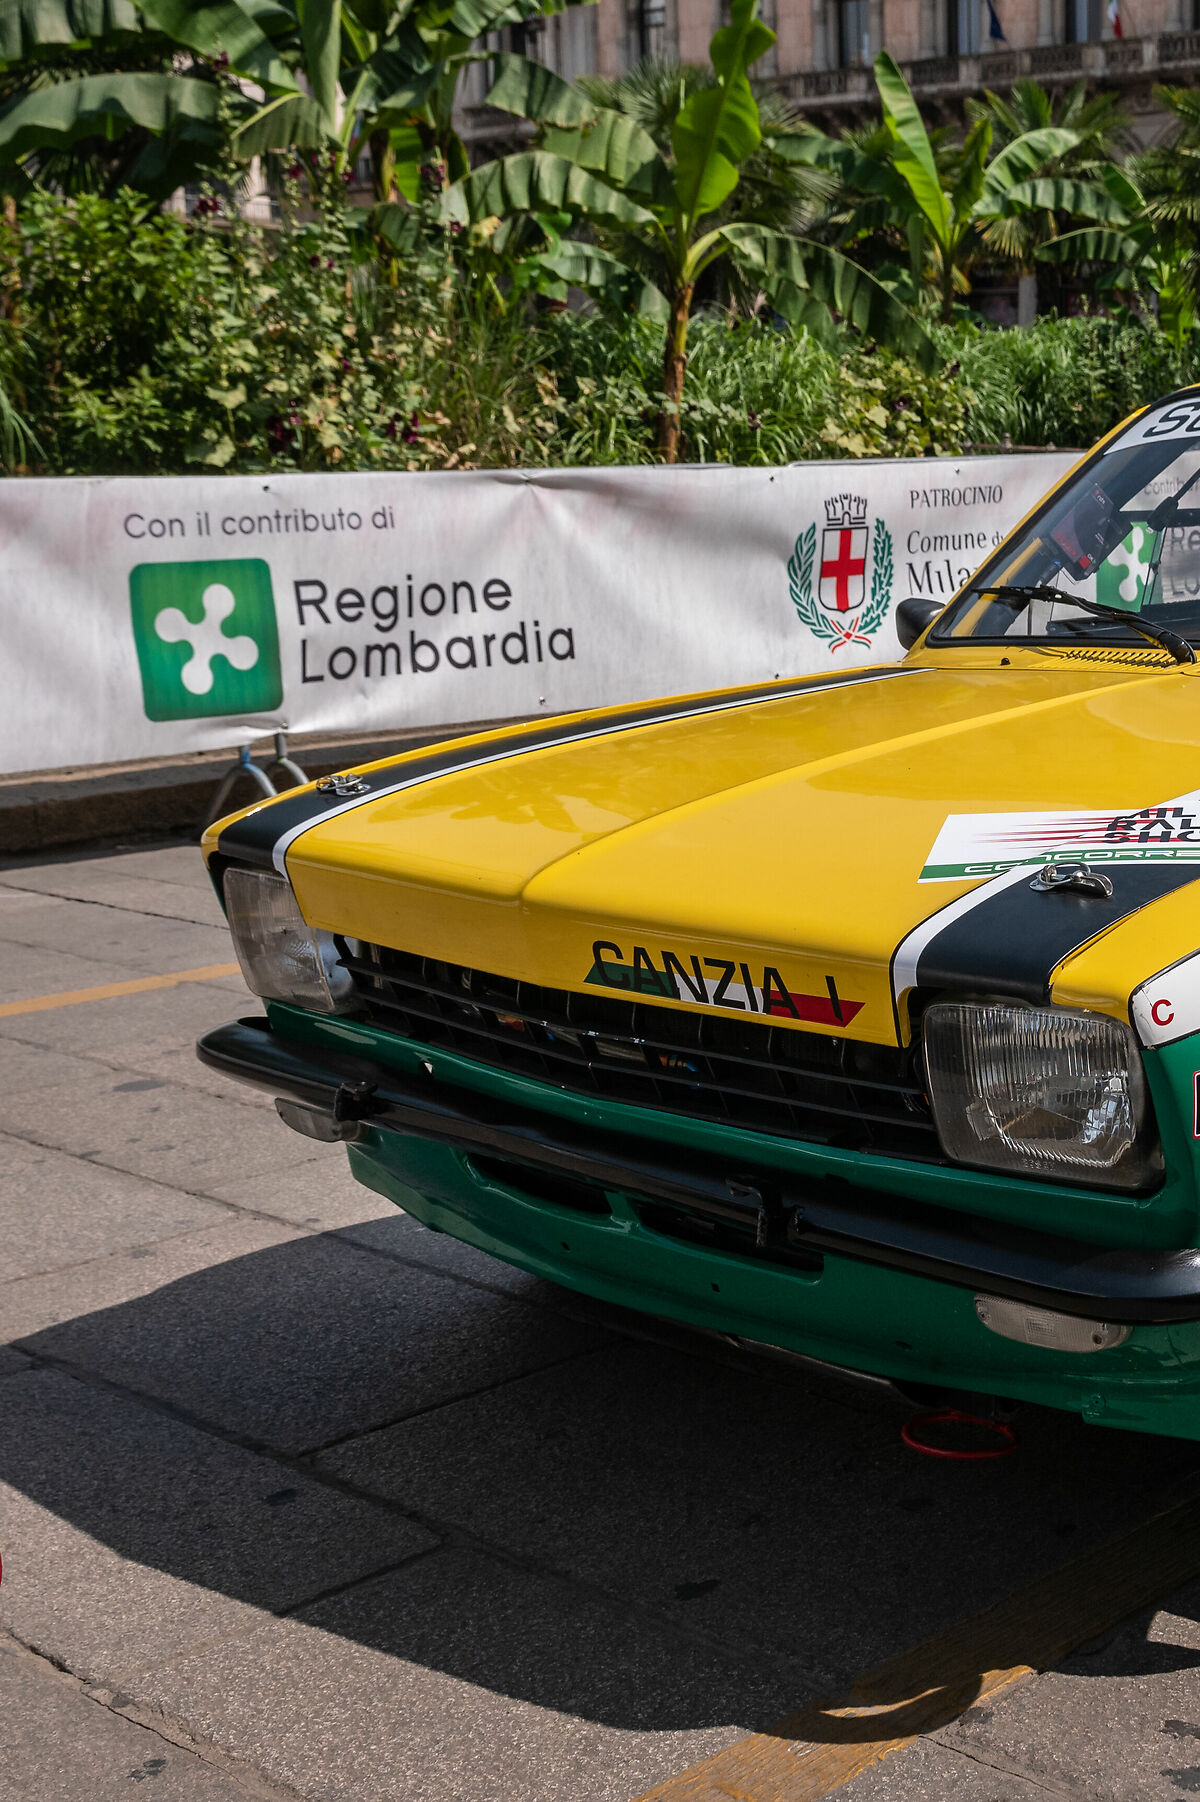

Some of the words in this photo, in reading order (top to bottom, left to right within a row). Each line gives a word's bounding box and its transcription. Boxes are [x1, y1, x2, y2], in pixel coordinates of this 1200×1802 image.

[910, 485, 1003, 508] PATROCINIO
[124, 513, 185, 539] Con
[197, 512, 211, 536] il
[221, 507, 363, 535] contributo
[372, 506, 395, 530] di
[907, 530, 987, 554] Comune
[906, 559, 977, 596] Mila
[294, 574, 513, 632] Regione
[300, 620, 576, 684] Lombardia
